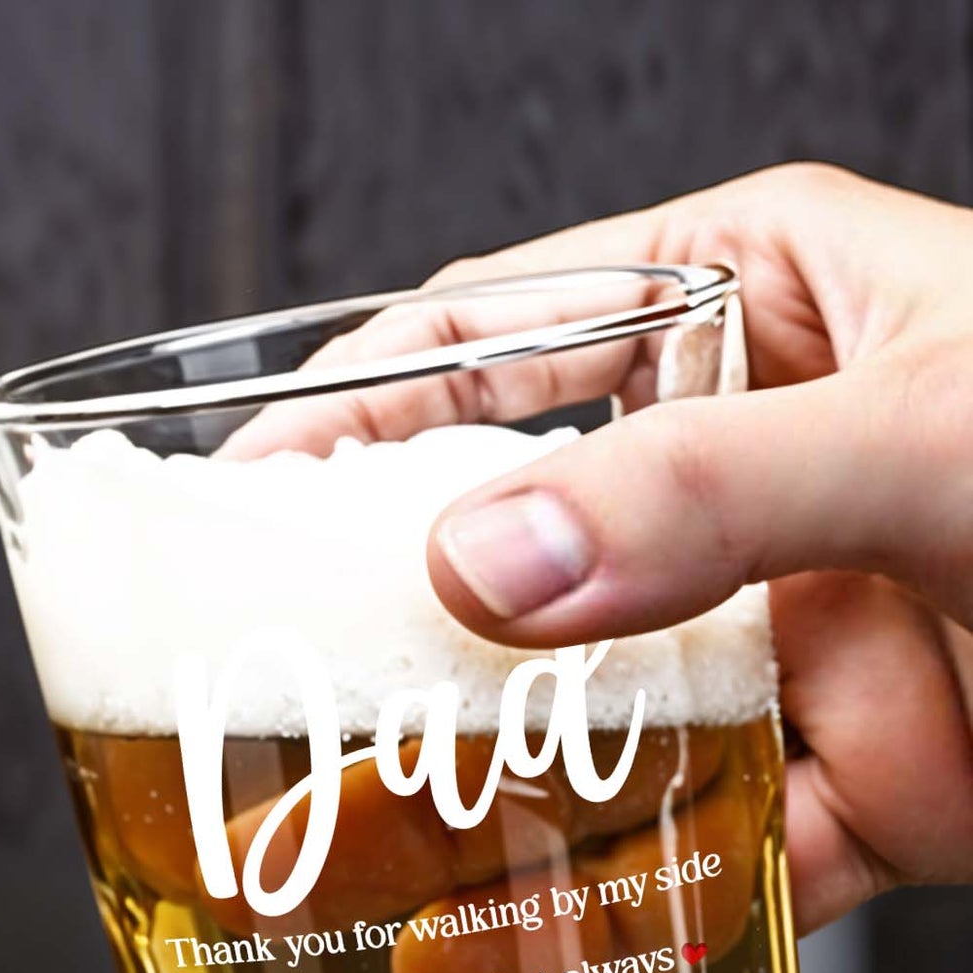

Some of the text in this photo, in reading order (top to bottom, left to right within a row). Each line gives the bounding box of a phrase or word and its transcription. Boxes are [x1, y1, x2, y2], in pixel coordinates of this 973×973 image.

[173, 625, 646, 916] Dad
[165, 850, 723, 968] Thank you for walking by my side
